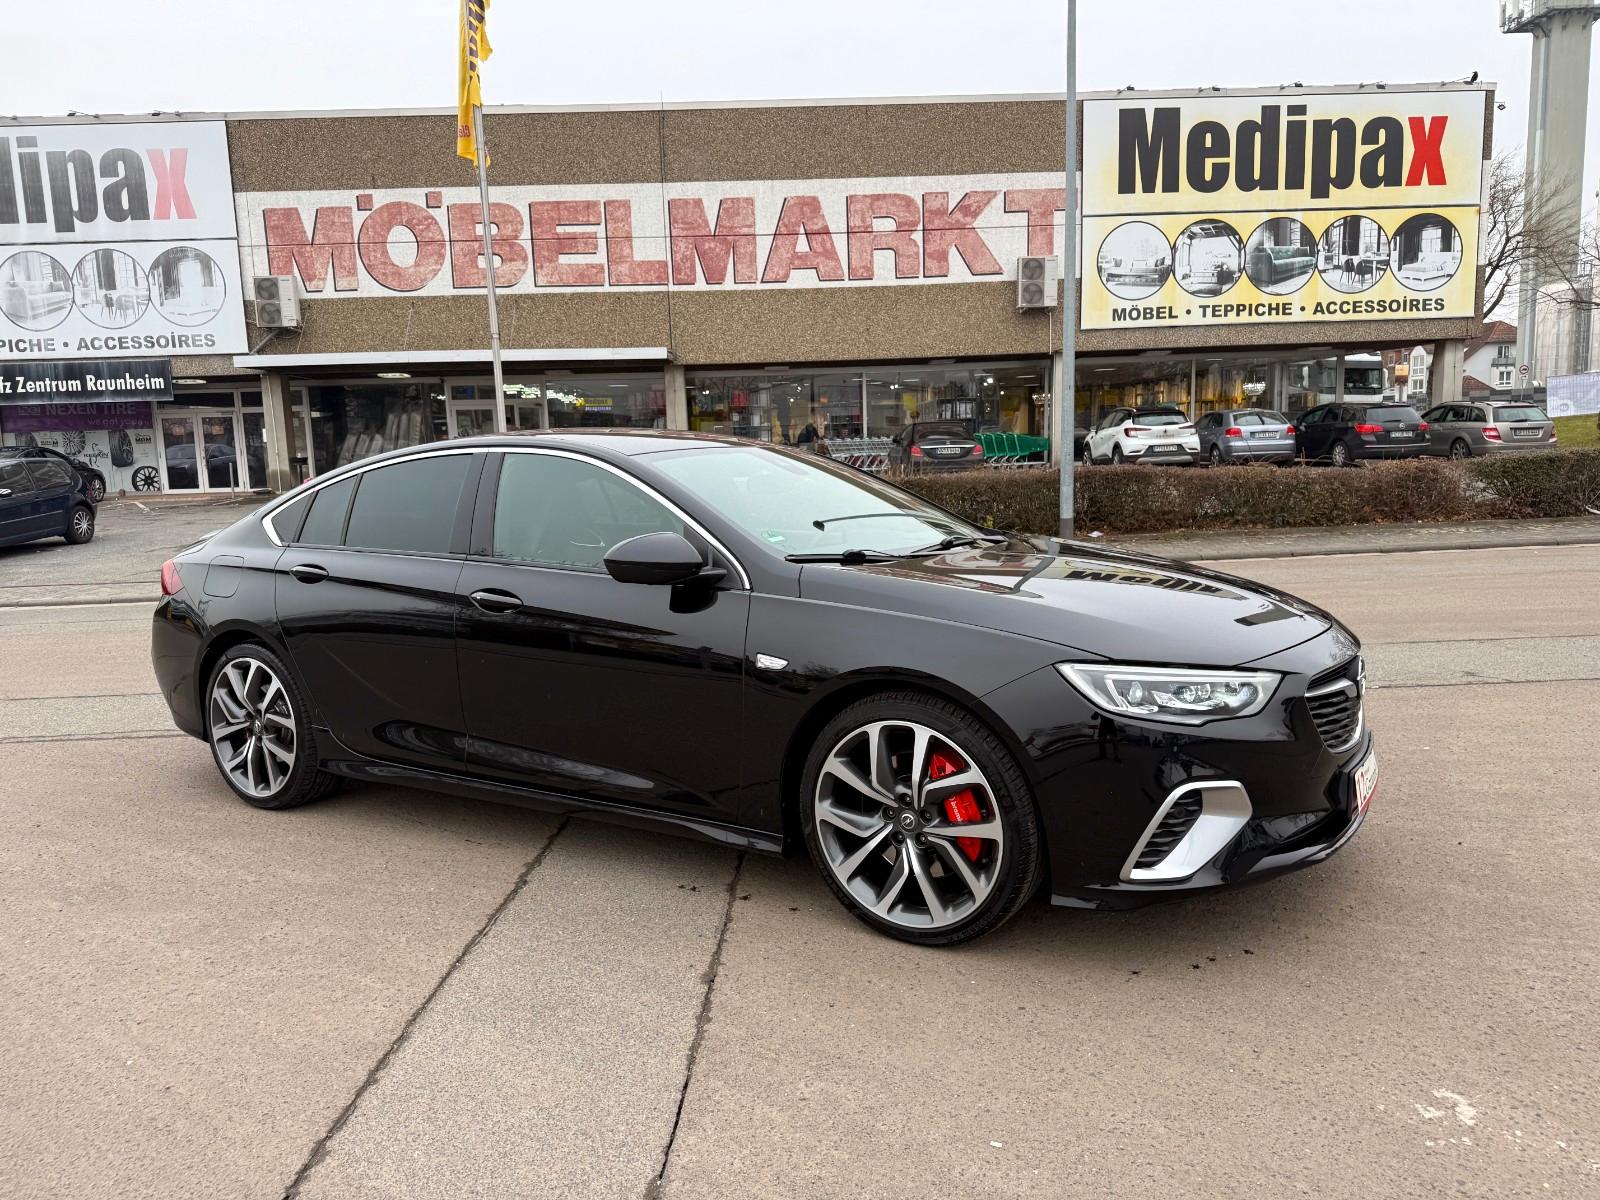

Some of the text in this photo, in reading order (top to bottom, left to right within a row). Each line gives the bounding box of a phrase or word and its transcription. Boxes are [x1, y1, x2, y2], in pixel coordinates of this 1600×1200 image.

[1118, 104, 1449, 199] Medipax
[263, 187, 1078, 292] MÖBELMARKT
[1112, 303, 1178, 322] MÖBEL
[1199, 302, 1293, 319] TEPPICHE
[16, 376, 82, 393] Zentrum
[86, 373, 165, 391] Raunheim
[46, 403, 97, 416] NEXEN
[103, 402, 137, 415] TIRE
